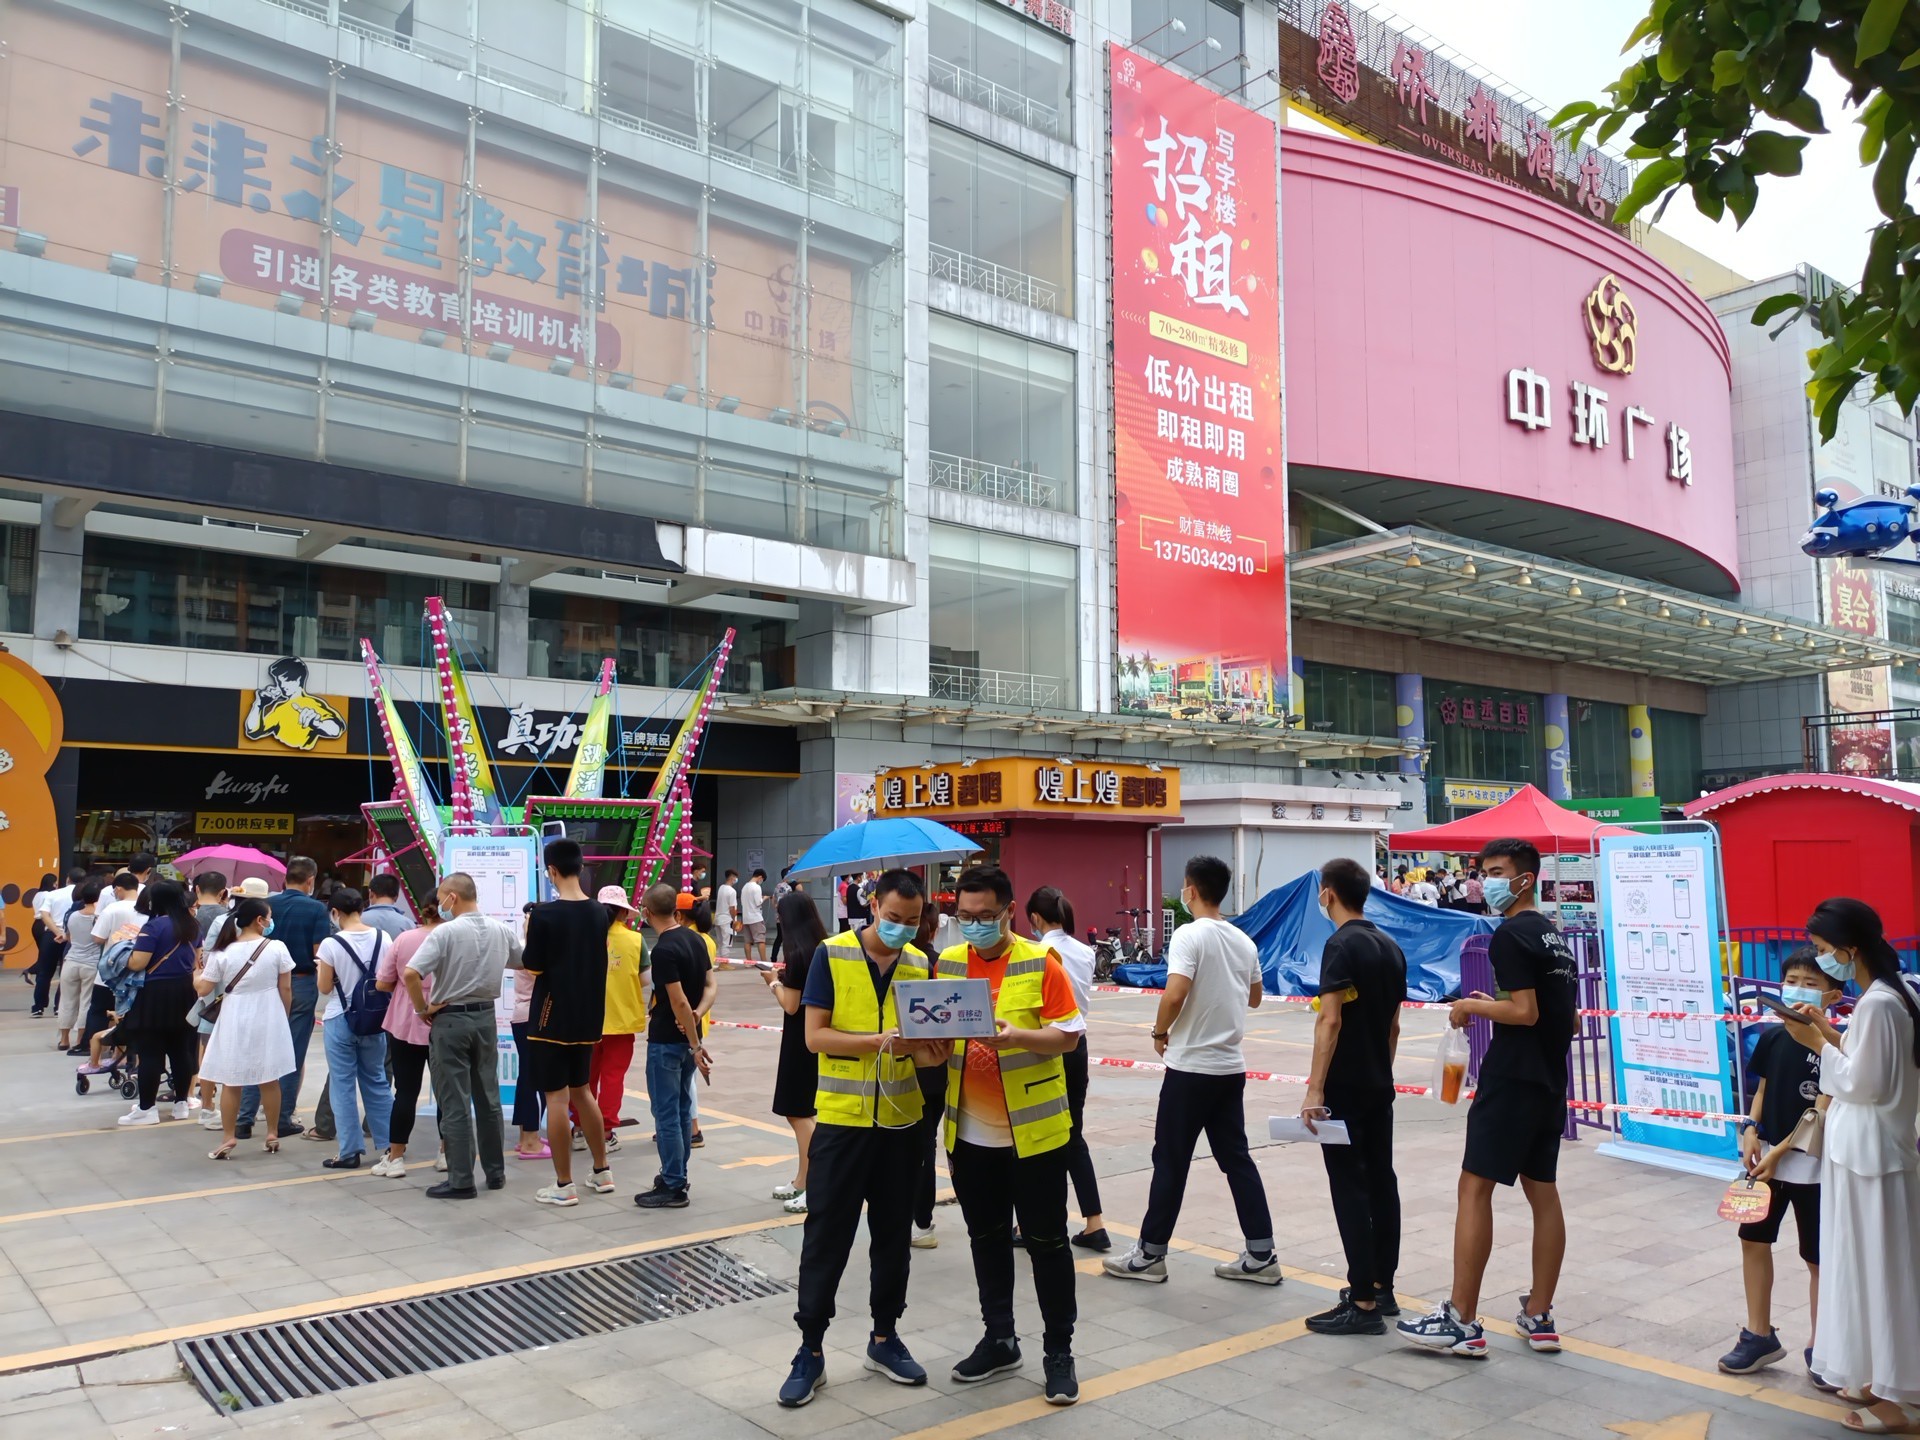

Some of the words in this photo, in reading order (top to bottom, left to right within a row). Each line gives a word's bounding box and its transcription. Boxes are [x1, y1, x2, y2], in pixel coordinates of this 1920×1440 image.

[1214, 126, 1237, 228] 写字楼
[1422, 133, 1484, 174] OVERSEAS
[1142, 114, 1250, 317] 招租
[1143, 354, 1255, 422] 低价出租
[1157, 408, 1246, 461] 即租即用
[1506, 365, 1693, 487] 中环广场
[1165, 456, 1240, 498] 成熟商圈
[1178, 515, 1233, 544] 财富热线
[1152, 539, 1255, 576] 13750342910
[1836, 583, 1871, 631] 宴会
[497, 701, 588, 760] 真功
[621, 730, 672, 748] 金牌蒸品
[200, 816, 290, 831] 7:00供应早餐
